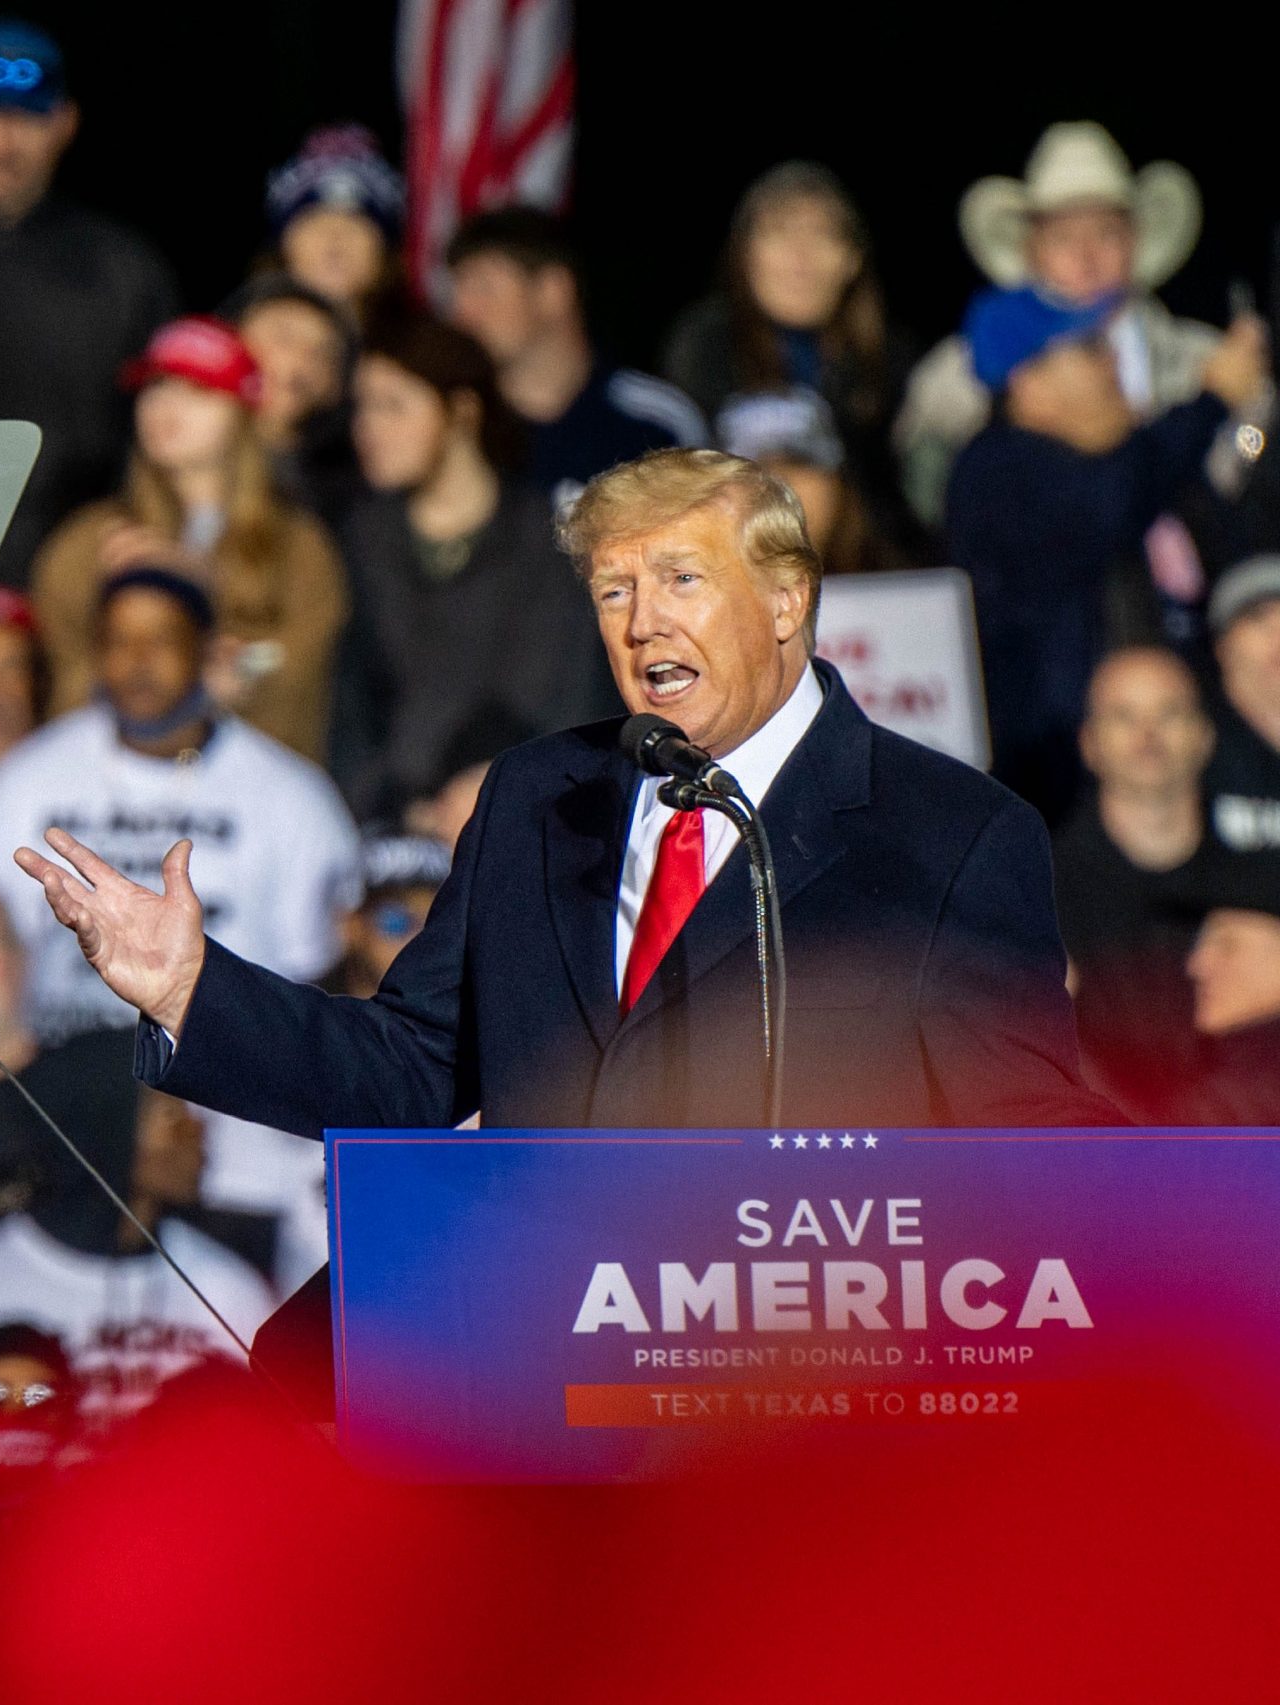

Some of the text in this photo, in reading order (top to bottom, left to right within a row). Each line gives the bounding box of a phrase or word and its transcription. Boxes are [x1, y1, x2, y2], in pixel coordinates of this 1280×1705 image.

[736, 1198, 925, 1248] SAVE
[572, 1258, 1095, 1334] AMERICA
[634, 1345, 1035, 1368] PRESIDENT DONALD J. TRUMP
[651, 1392, 1020, 1417] TEXT TEXAS TO 88022
